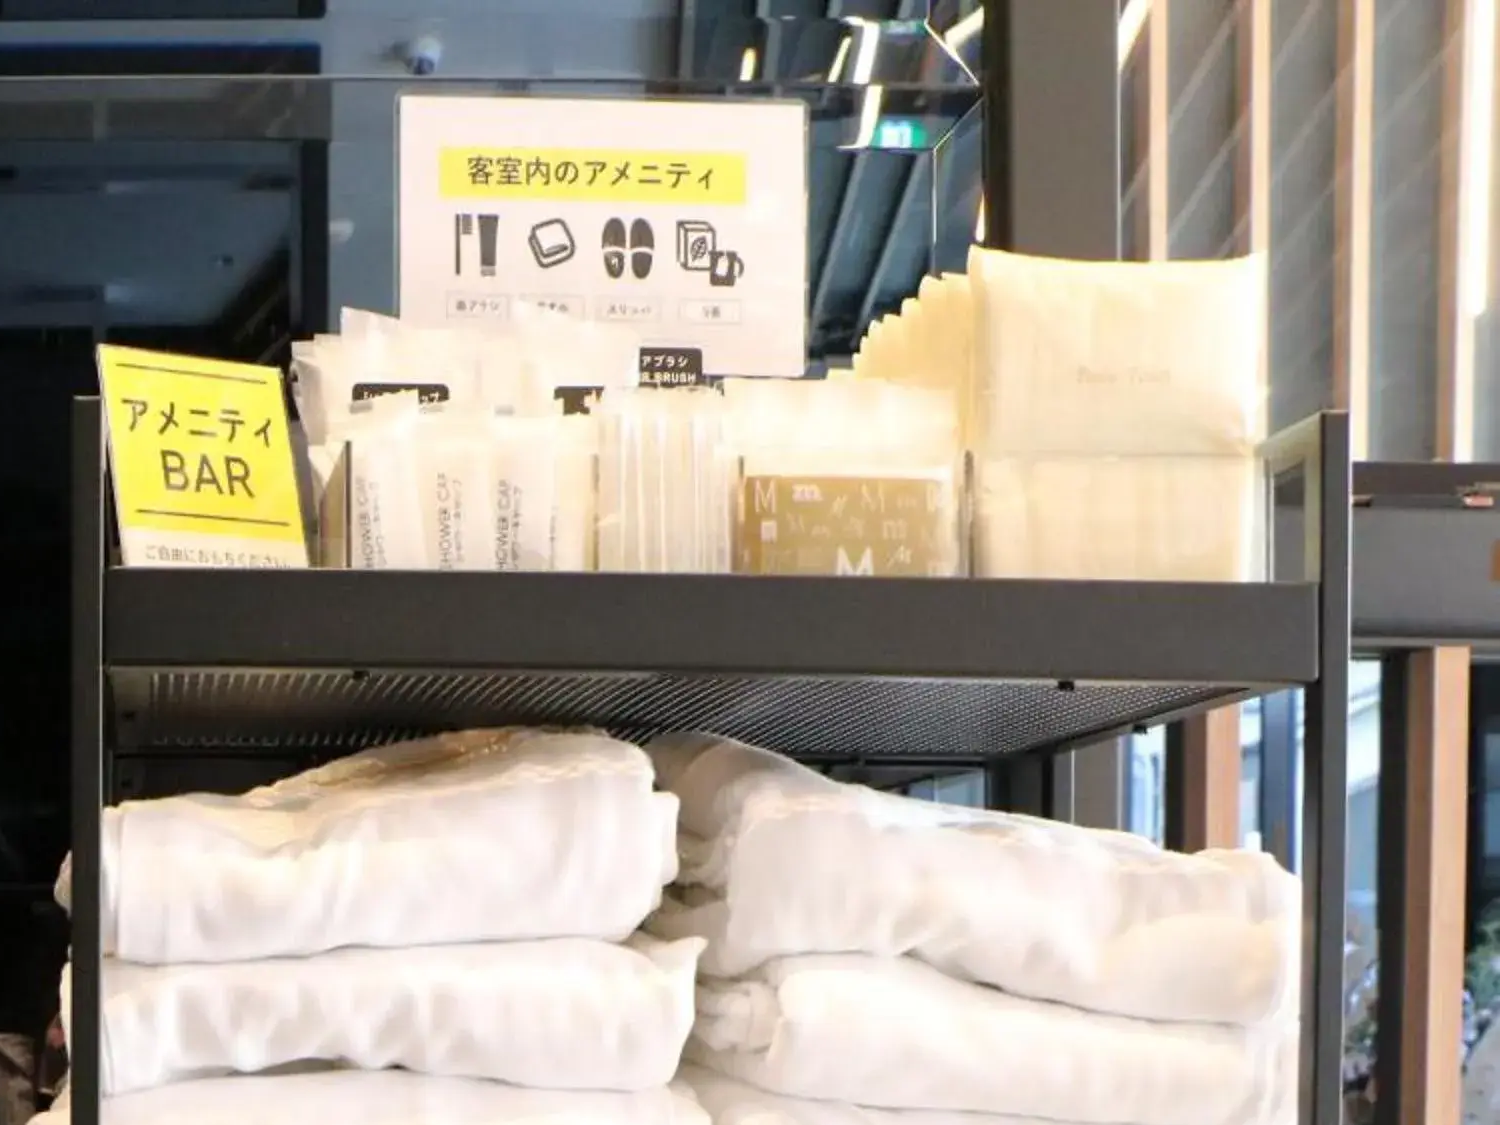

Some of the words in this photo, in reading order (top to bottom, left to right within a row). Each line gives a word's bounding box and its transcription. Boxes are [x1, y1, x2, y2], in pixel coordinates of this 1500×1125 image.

[467, 155, 714, 190] 客室内のアメニティ
[121, 399, 272, 448] アメニティ
[160, 449, 256, 499] BAR
